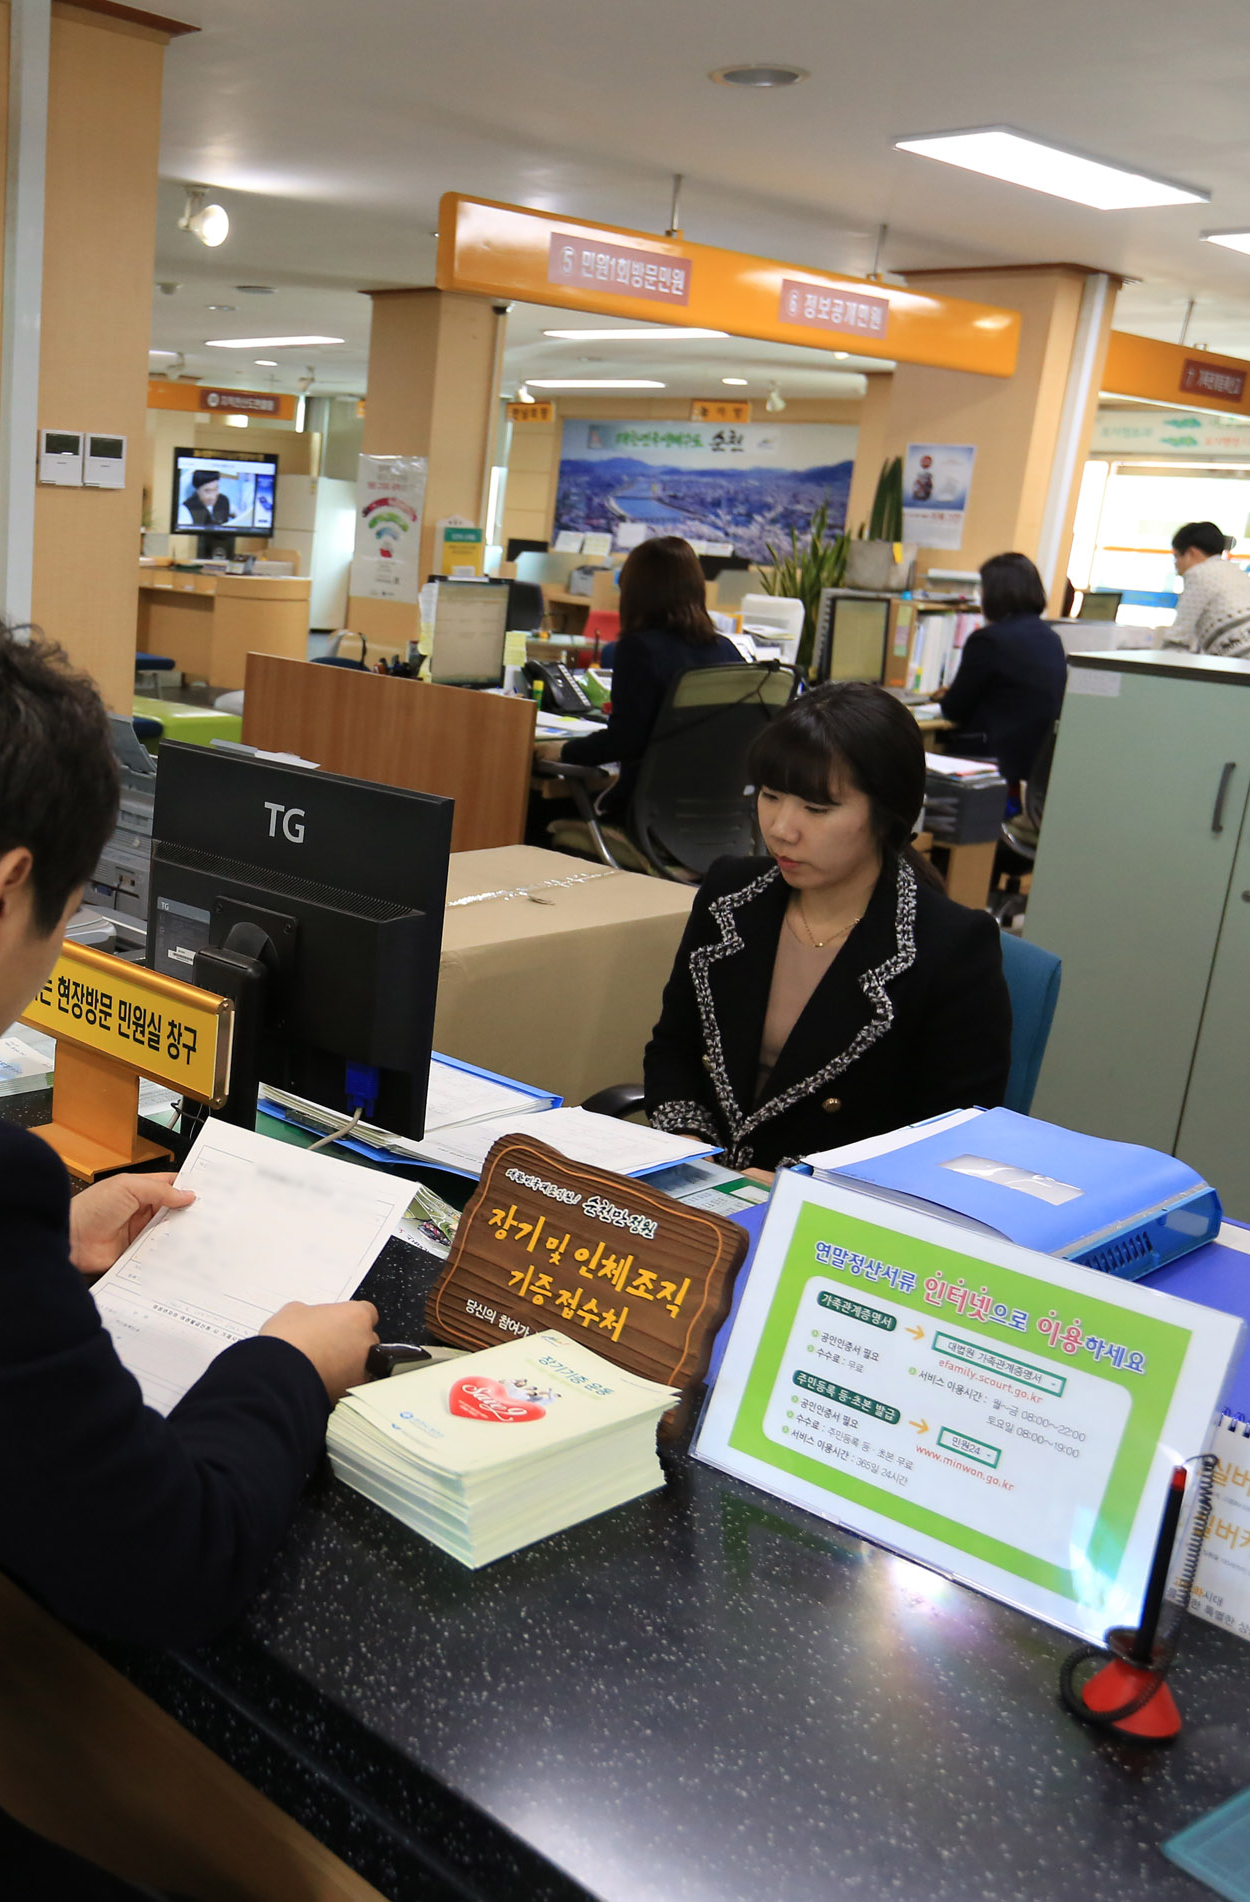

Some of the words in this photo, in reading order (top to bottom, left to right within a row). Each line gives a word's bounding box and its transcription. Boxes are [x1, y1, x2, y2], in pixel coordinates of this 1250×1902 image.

[581, 250, 686, 296] 민원1회방문민원
[264, 801, 306, 845] TG
[58, 976, 113, 1031] 현장방문
[118, 1000, 162, 1052] 민원실
[167, 1019, 197, 1065] 창구
[487, 1204, 546, 1252] 장기
[545, 1233, 571, 1265] 및
[582, 1195, 658, 1240] 순천만정원
[465, 1299, 497, 1324] 당신의
[508, 1265, 554, 1305] 기증
[555, 1287, 629, 1342] 접수처
[815, 1240, 917, 1293] 연말정산서류
[923, 1273, 1030, 1333] 인터넷으로
[1036, 1313, 1146, 1375] 이용하세요
[821, 1292, 893, 1329] 가족관계증명서
[816, 1348, 841, 1363] 수수료
[820, 1332, 861, 1355] 공인인증서
[863, 1347, 879, 1362] 필요
[947, 1341, 975, 1359] 대법원
[977, 1352, 1043, 1384] 가족관계증명서
[538, 1355, 588, 1385] 장기기증
[918, 1370, 945, 1387] 서비스
[938, 1359, 1044, 1404] efamily.scourt.go.kr
[796, 1372, 836, 1397] 주민등록
[874, 1403, 896, 1421] 발급
[800, 1398, 840, 1422] 공인인증서
[842, 1414, 859, 1429] 필요
[795, 1414, 820, 1430] 수수료
[986, 1415, 1014, 1434] 토요일
[791, 1429, 815, 1446] 서비스
[880, 1468, 908, 1487] 24시간
[952, 1436, 981, 1455] 민원24
[916, 1445, 1015, 1491] www.minwon.go.kr
